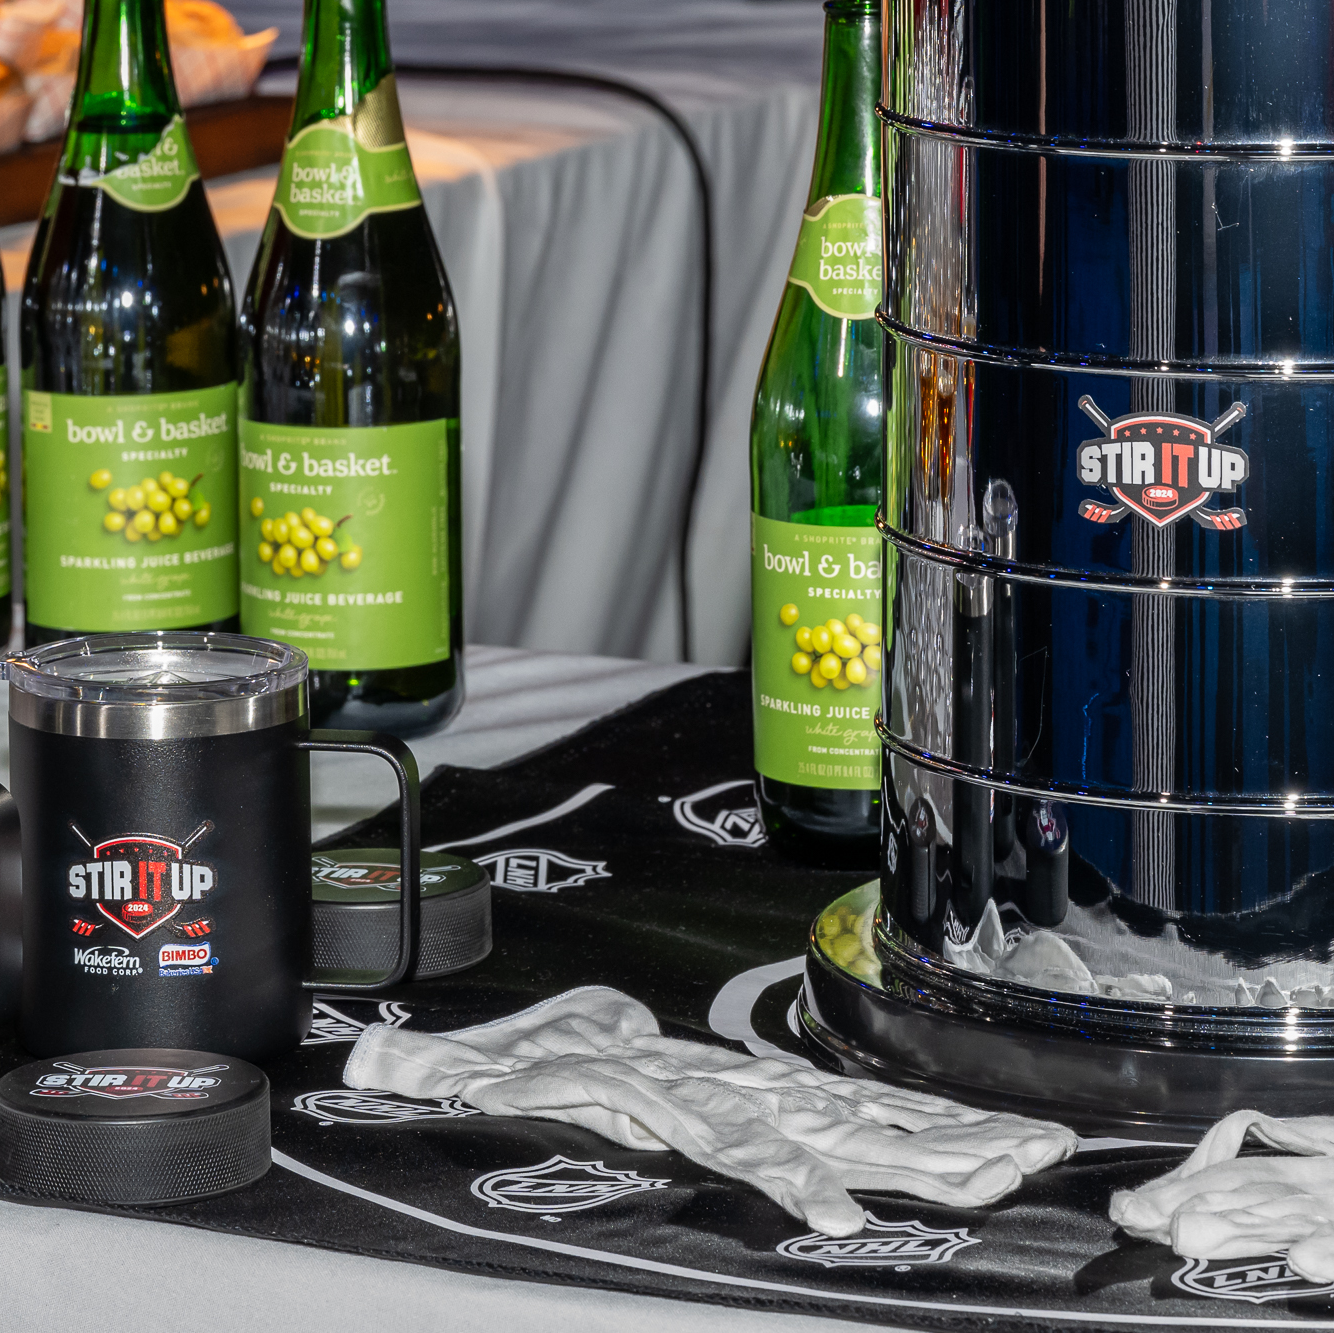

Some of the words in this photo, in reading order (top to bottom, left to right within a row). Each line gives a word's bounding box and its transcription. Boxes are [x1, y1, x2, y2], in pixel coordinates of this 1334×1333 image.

[291, 162, 336, 183] bowl
[289, 183, 356, 205] basket
[819, 259, 882, 281] baske
[66, 417, 126, 445] bowl
[131, 420, 155, 444] &
[160, 411, 230, 442] basket
[121, 447, 189, 462] SPECIALTY
[277, 451, 298, 476] &
[301, 451, 392, 478] basket
[1080, 441, 1155, 484] STIR
[1161, 442, 1195, 488] IT
[1198, 445, 1245, 489] UP
[269, 481, 333, 496] SPECIALTY
[1149, 487, 1174, 498] 2024
[860, 537, 882, 545] BRA
[60, 554, 137, 570] SPARKLING
[140, 552, 180, 570] JUICE
[763, 543, 811, 576] bowl
[817, 554, 841, 578] &
[284, 591, 323, 607] JUICE
[327, 590, 404, 607] BEVERAGE
[808, 586, 882, 599] SPECIALTY
[760, 694, 821, 717] SPARKLING
[826, 706, 870, 719] JUICE
[843, 727, 878, 746] grap
[808, 745, 827, 754] FROM
[829, 747, 879, 756] CONCENTRAT
[69, 860, 133, 901] STIR
[138, 860, 167, 902] IT
[171, 862, 214, 901] UP
[368, 869, 401, 881] IT
[127, 903, 149, 913] 2024
[73, 945, 141, 969] Wakefern
[161, 948, 209, 962] BIMBO
[84, 966, 109, 975] FOOD
[43, 1074, 127, 1087] STIR
[130, 1074, 167, 1087] IT
[167, 1076, 217, 1088] UP
[497, 1181, 634, 1193] LNH
[810, 1239, 932, 1254] NHL
